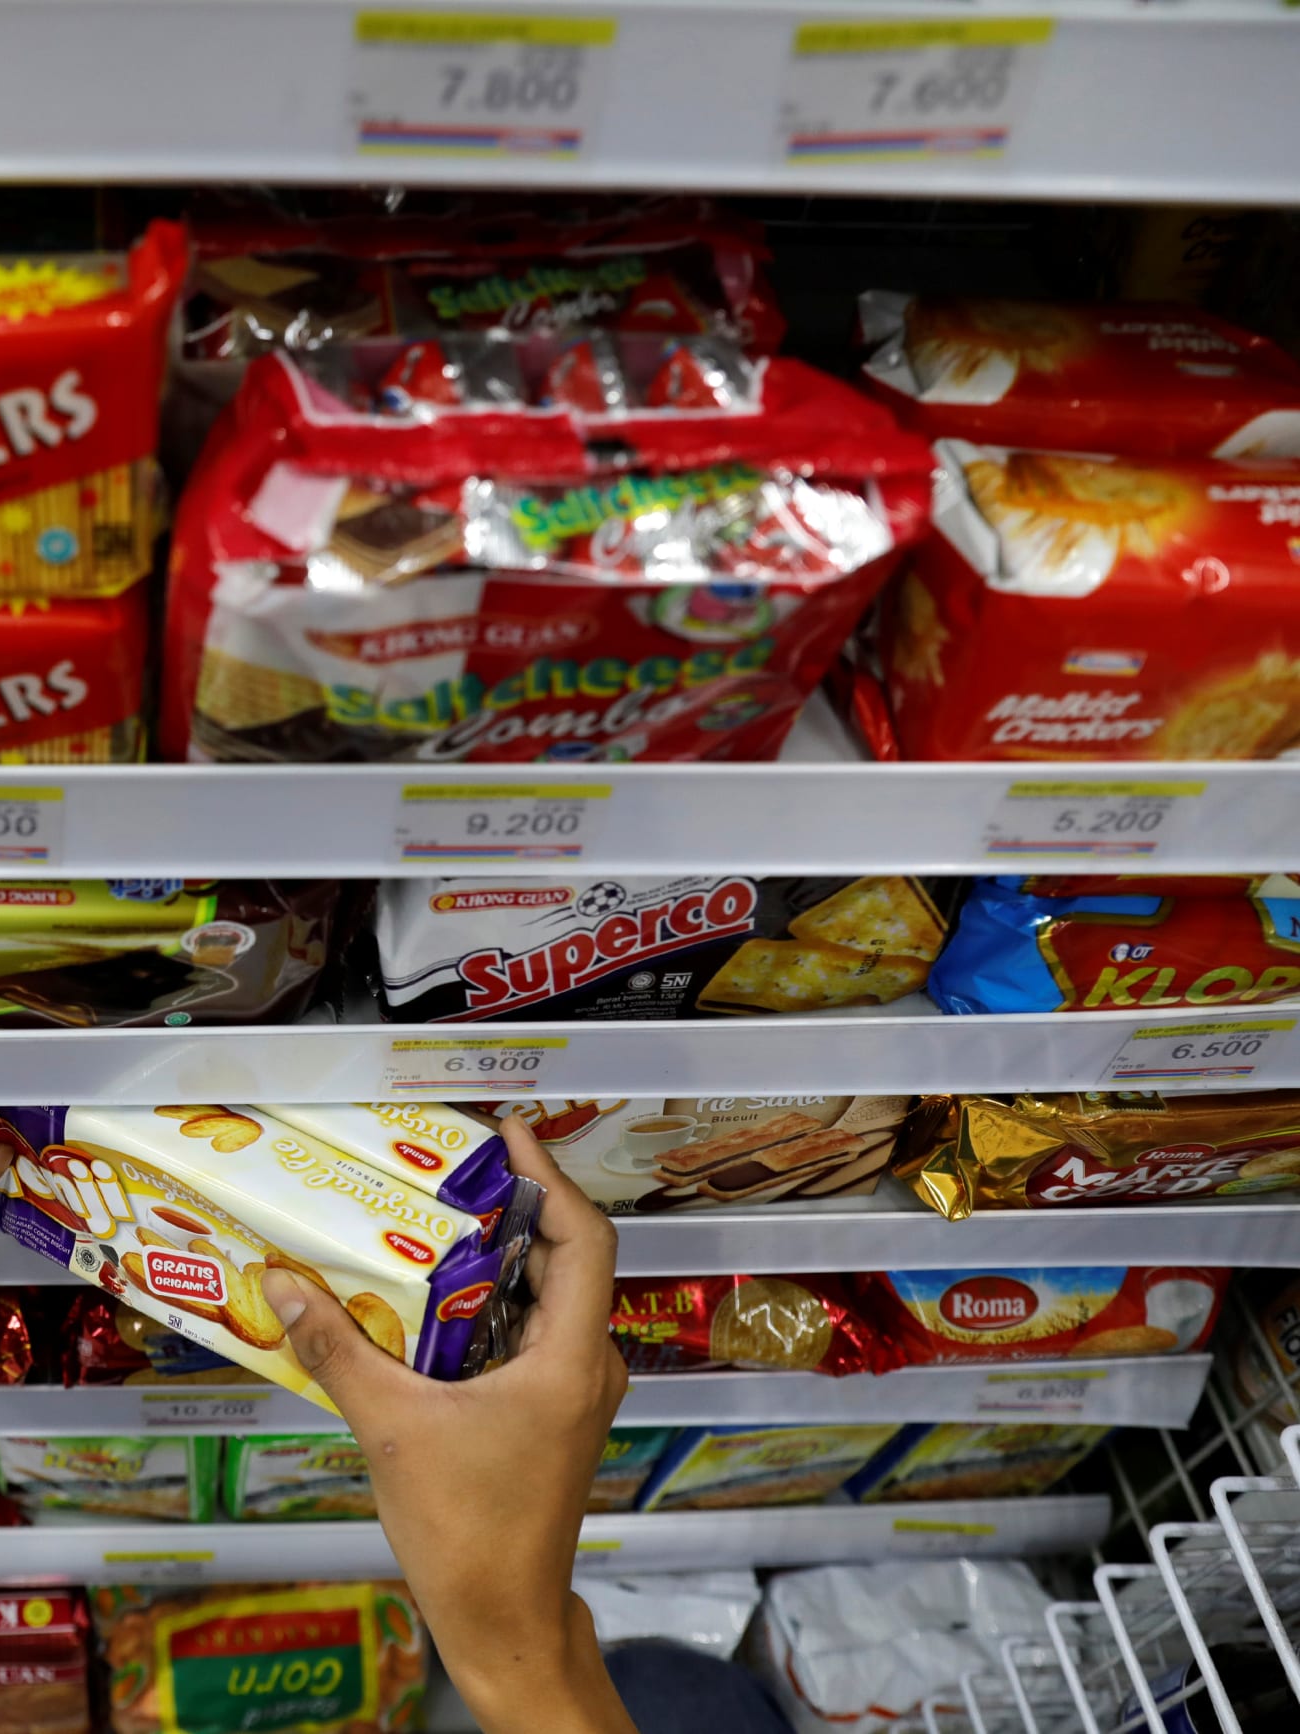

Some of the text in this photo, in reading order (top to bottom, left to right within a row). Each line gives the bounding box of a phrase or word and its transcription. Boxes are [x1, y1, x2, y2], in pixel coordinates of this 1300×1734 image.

[437, 66, 579, 112] 7.800
[869, 72, 1010, 114] 7.600
[465, 812, 580, 836] 9.200
[1052, 809, 1165, 834] 5.200
[455, 889, 566, 908] KHONG GUAN
[458, 882, 753, 1008] Superco
[1131, 945, 1155, 959] OT
[660, 972, 692, 989] SNI
[1171, 1039, 1263, 1060] 6.500
[444, 1056, 541, 1072] 6.900
[711, 1113, 759, 1124] Biscuit
[274, 1138, 317, 1171] Pie
[398, 1142, 437, 1168] Monde
[1146, 1150, 1205, 1162] Roma
[335, 1159, 384, 1189] Biscuit
[1053, 1154, 1251, 1188] MARIE
[122, 1161, 228, 1226] Original
[307, 1165, 454, 1241] Original
[611, 1199, 636, 1213] SNI
[388, 1233, 430, 1261] Monde
[151, 1257, 215, 1280] GRATIS
[154, 1276, 204, 1293] ORIGAMI
[952, 1292, 1028, 1320] Roma
[167, 1313, 183, 1330] SNI
[227, 1657, 343, 1696] Corn
